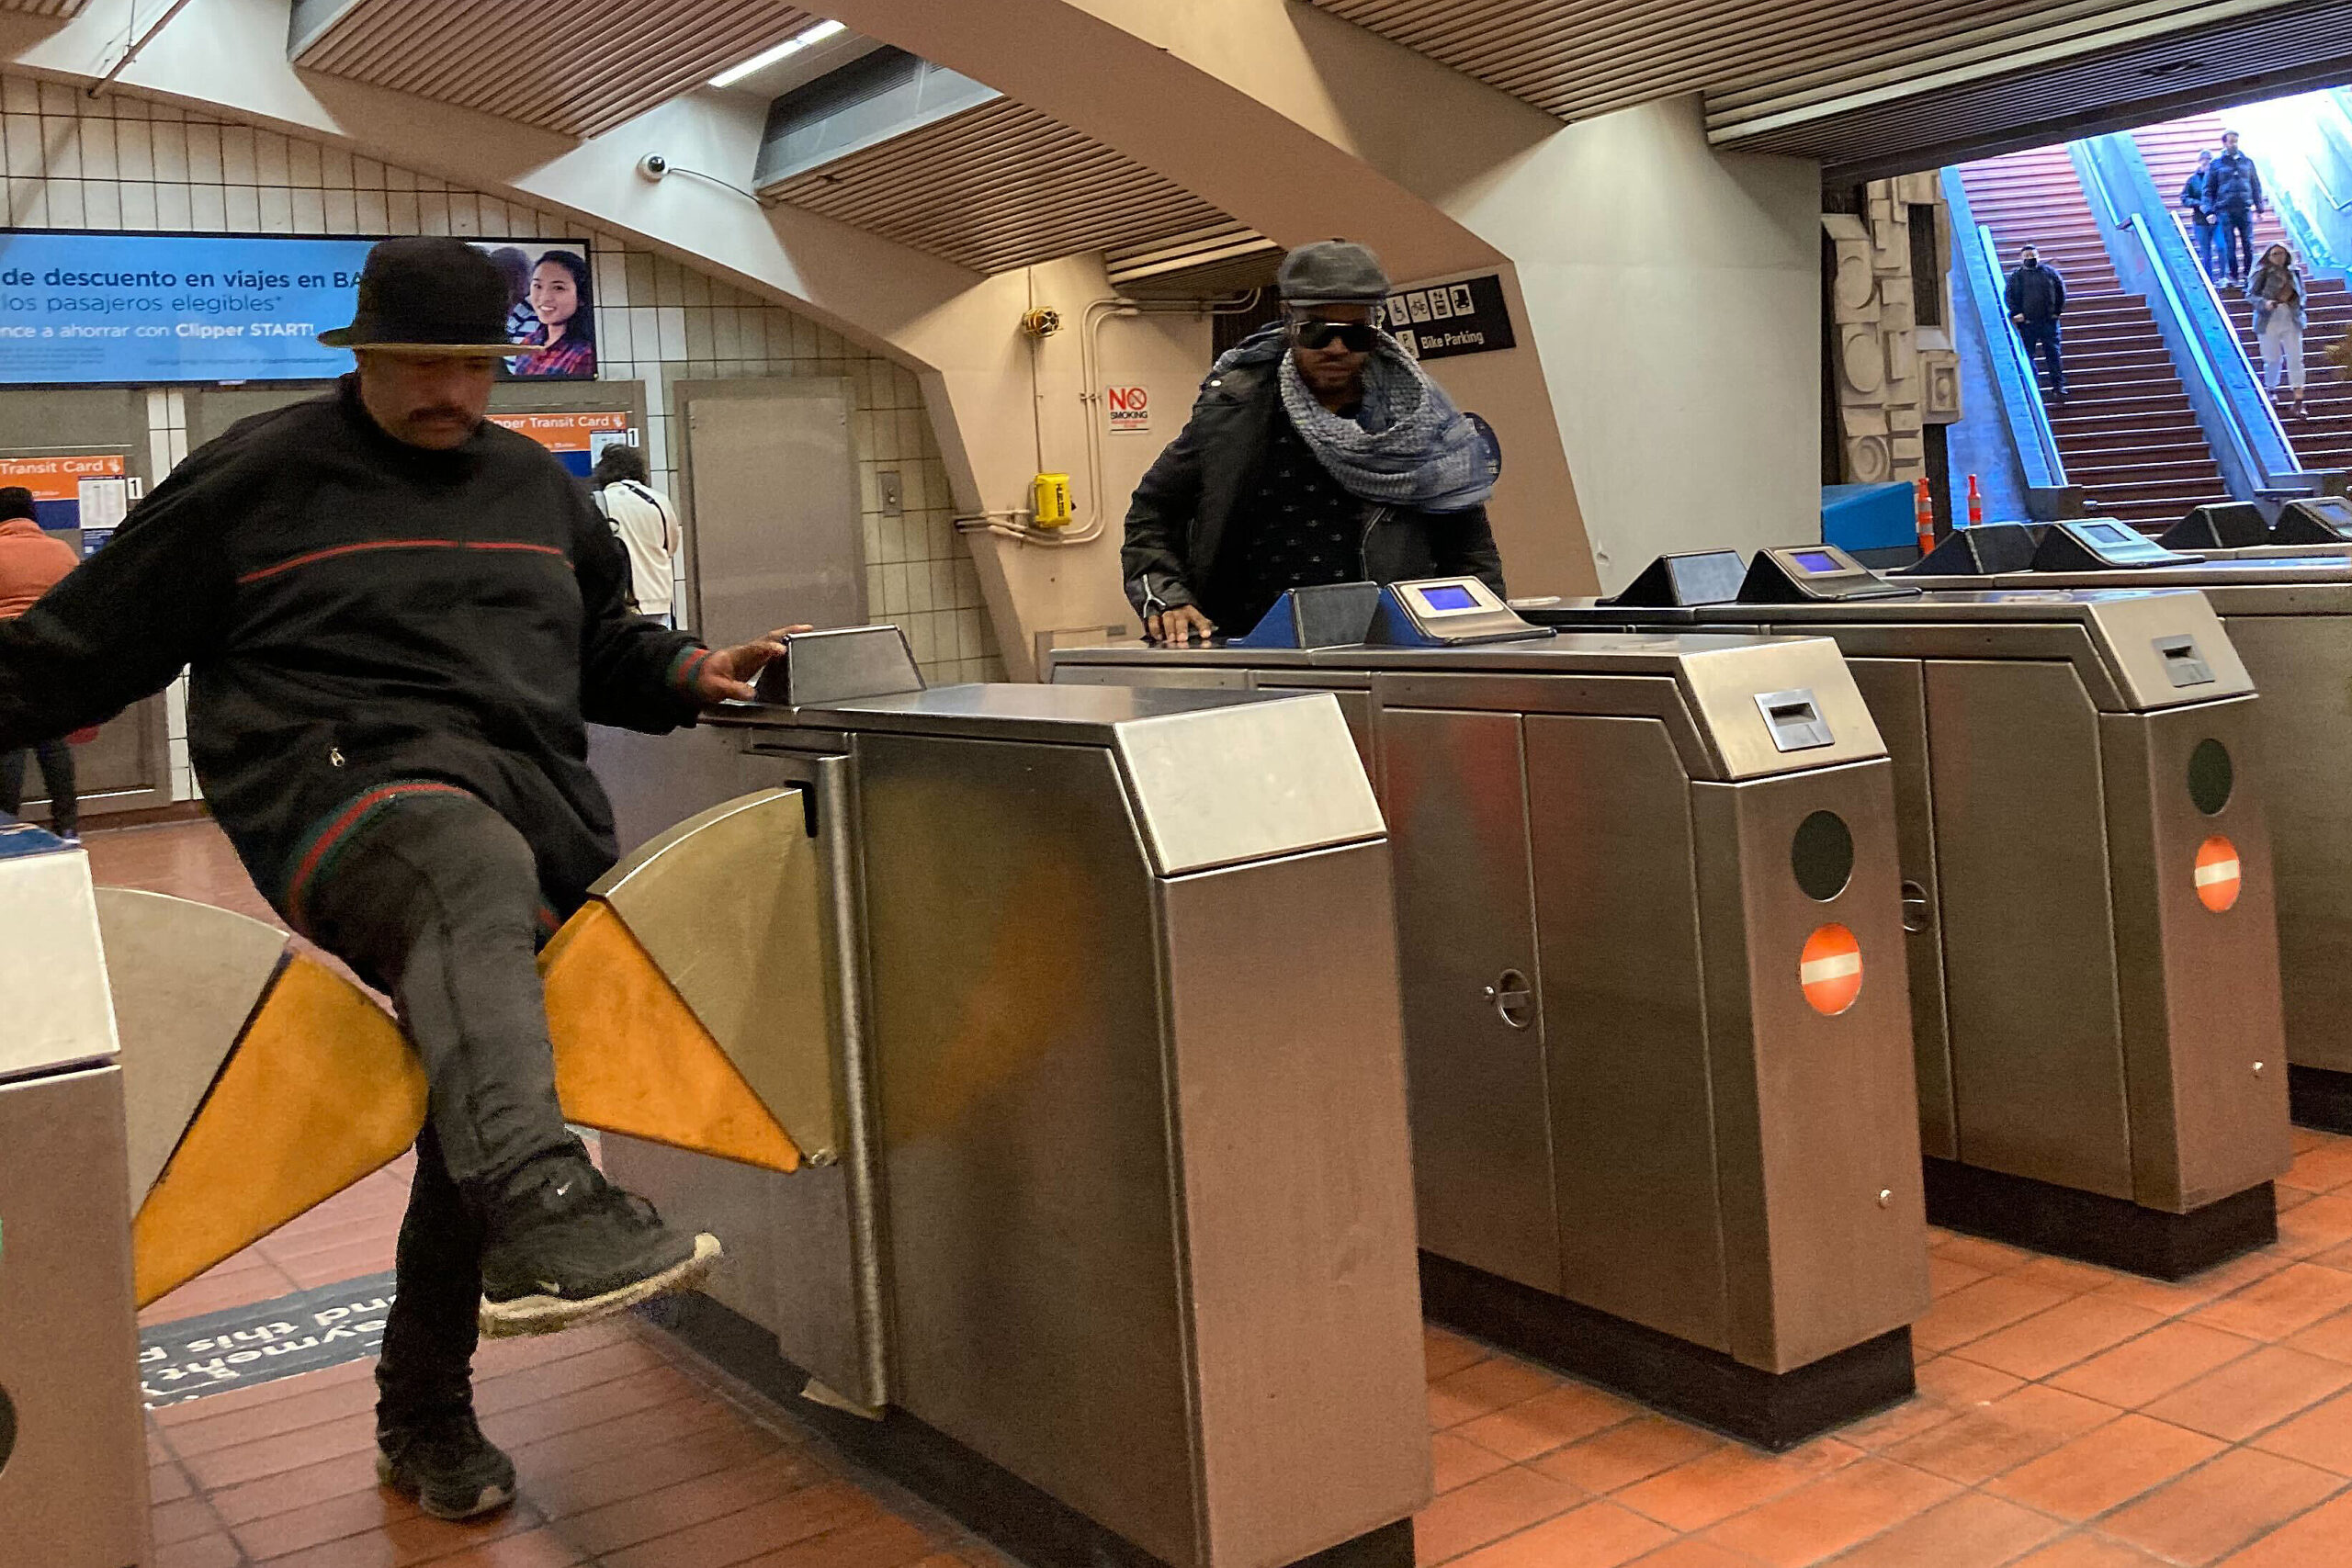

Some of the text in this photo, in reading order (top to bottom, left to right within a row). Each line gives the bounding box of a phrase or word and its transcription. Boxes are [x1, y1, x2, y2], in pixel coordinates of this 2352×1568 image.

[2, 267, 35, 286] de
[44, 267, 176, 287] descuento
[186, 273, 214, 287] en
[223, 270, 290, 291] viajes
[298, 275, 325, 288] en
[46, 295, 163, 314] pasajeros
[42, 326, 53, 337] a
[59, 323, 130, 338] ahorrar
[134, 326, 169, 337] con
[175, 323, 244, 339] Clipper
[250, 323, 314, 337] START!
[1420, 331, 1485, 349] Bike Parking
[529, 417, 574, 427] Transit
[578, 416, 609, 427] Card
[629, 430, 635, 446] 1
[1, 460, 104, 474] Transit Card
[129, 479, 137, 498] 1
[187, 1322, 299, 1352] this
